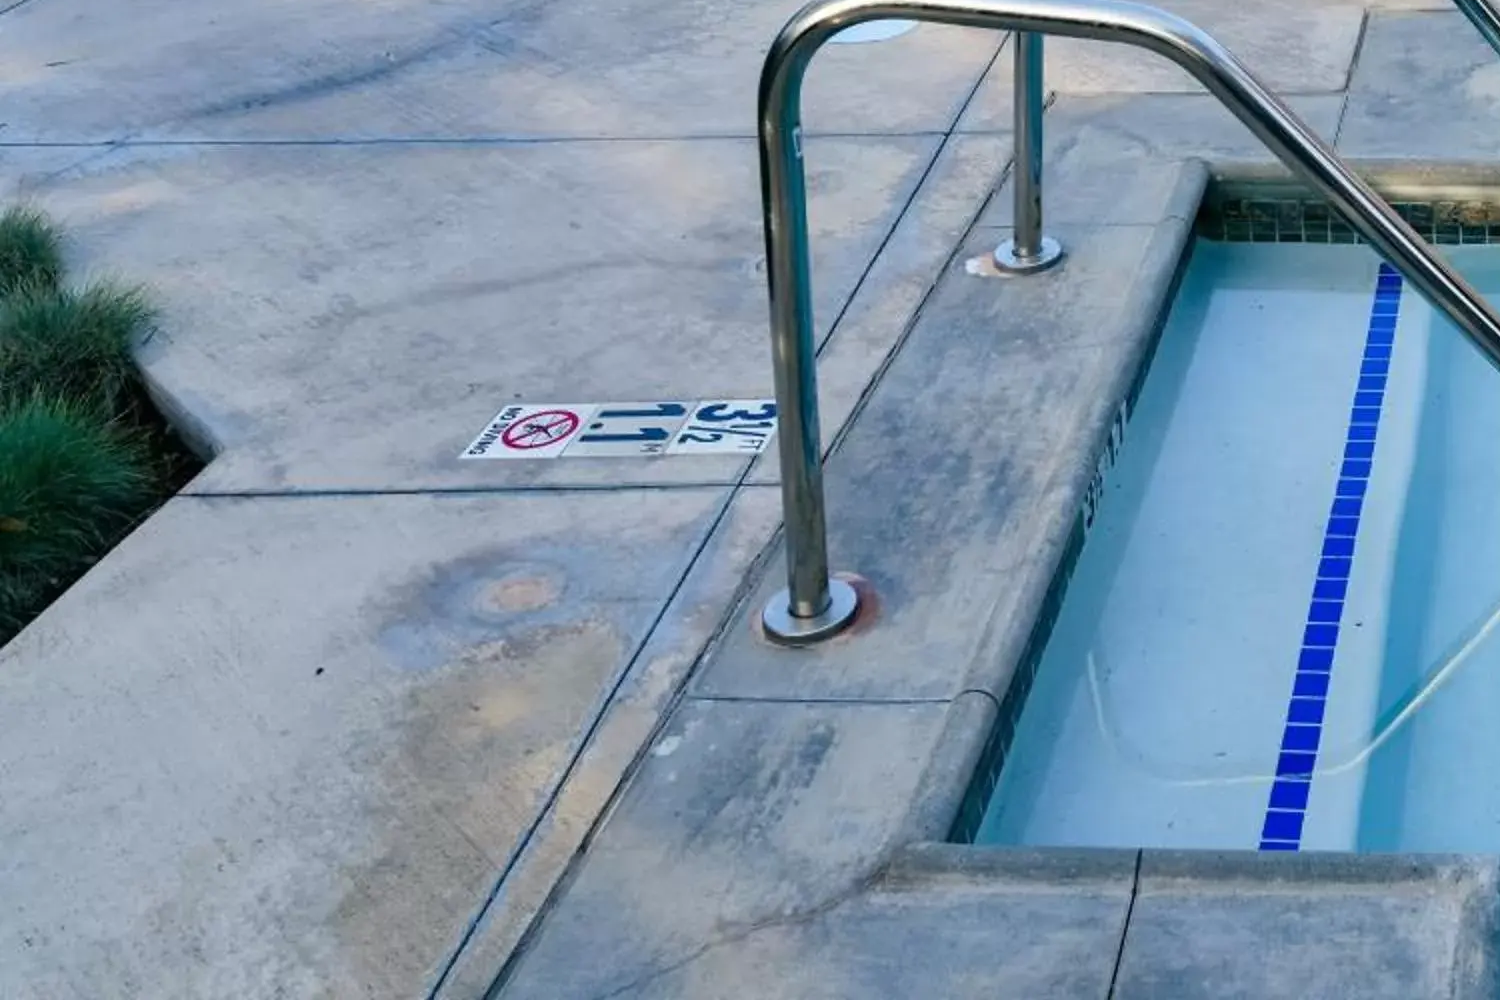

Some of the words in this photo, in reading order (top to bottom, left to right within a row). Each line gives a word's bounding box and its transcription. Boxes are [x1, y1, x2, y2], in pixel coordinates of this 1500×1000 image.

[500, 407, 523, 421] NO
[579, 403, 687, 443] 1.1
[467, 420, 511, 455] DIVING
